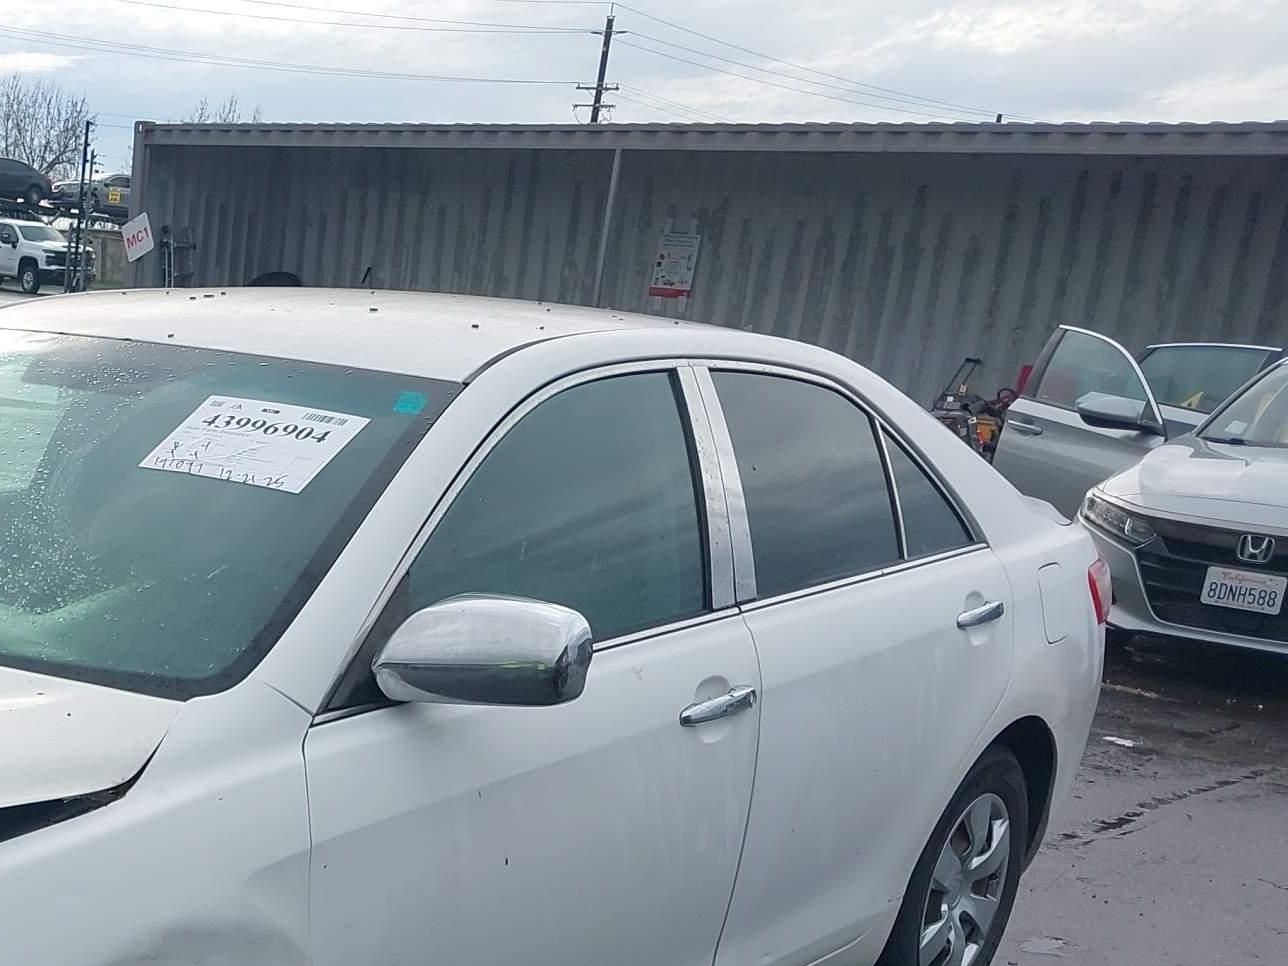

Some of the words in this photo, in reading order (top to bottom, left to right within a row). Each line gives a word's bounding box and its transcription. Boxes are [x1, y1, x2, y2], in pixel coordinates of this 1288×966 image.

[126, 227, 150, 249] MC1
[201, 413, 333, 444] 43996904
[1207, 582, 1278, 608] 8DNH588
